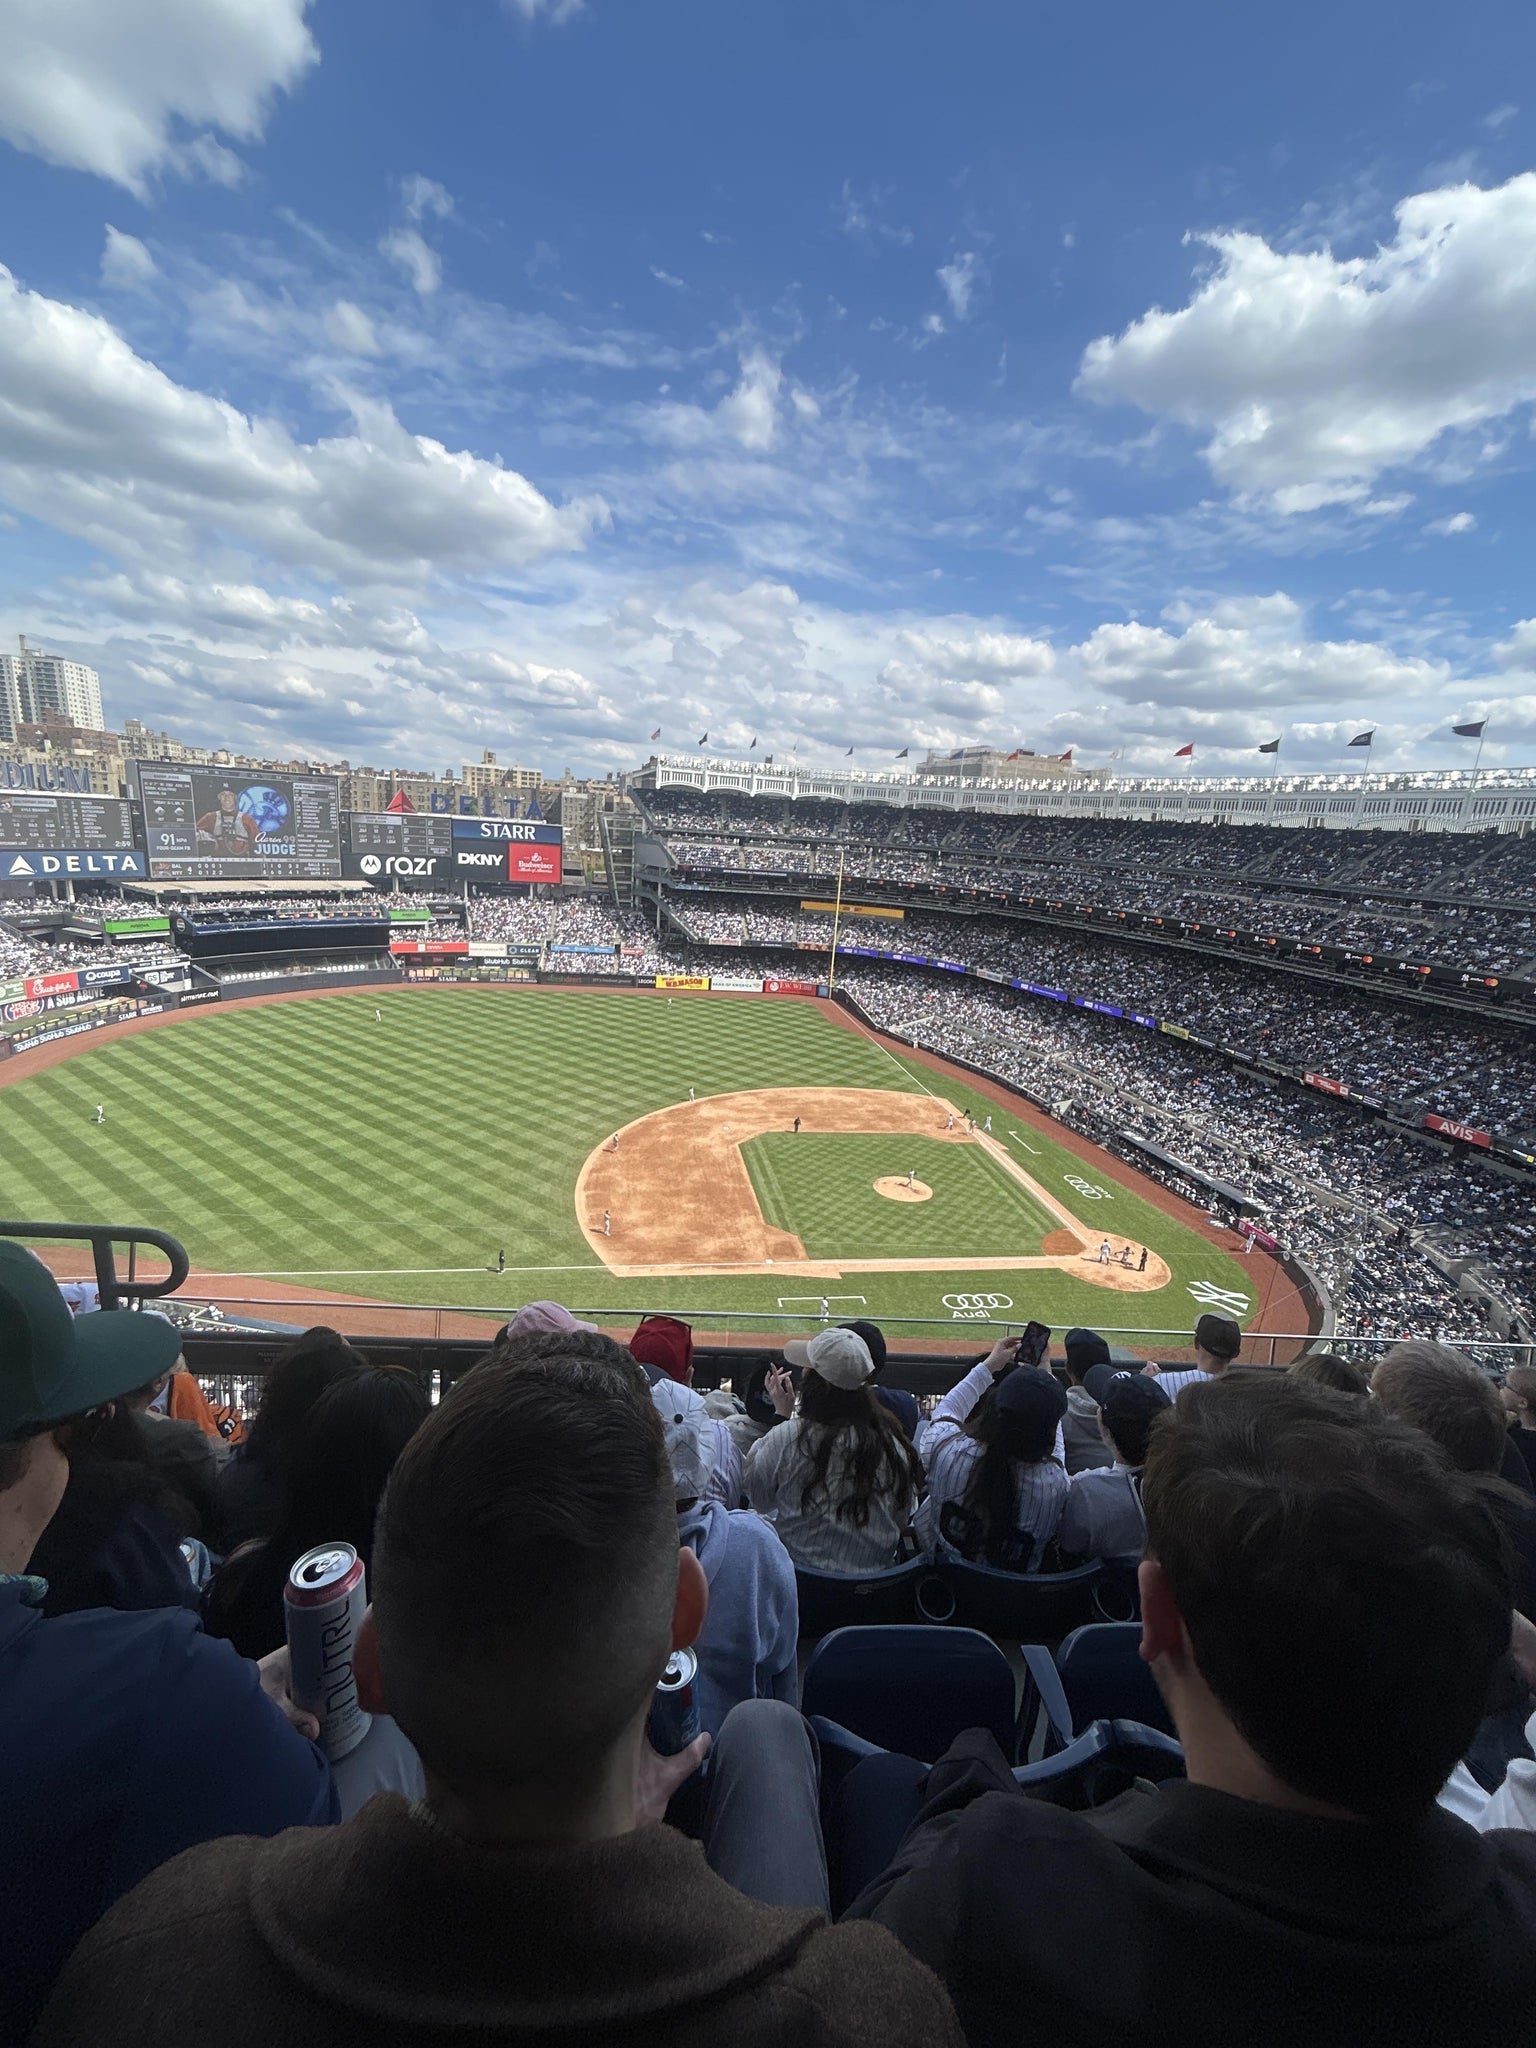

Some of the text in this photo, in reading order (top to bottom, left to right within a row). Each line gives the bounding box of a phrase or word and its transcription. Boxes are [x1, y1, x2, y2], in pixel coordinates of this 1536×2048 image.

[431, 793, 544, 820] DELTA
[480, 822, 536, 840] STARR
[160, 833, 175, 846] 91
[283, 835, 296, 844] 99
[254, 843, 296, 855] JUDGE
[42, 855, 138, 873] DELTA
[457, 852, 504, 866] DKNY
[518, 860, 554, 869] Budweiser
[385, 856, 437, 876] razr
[483, 957, 510, 966] StubHub
[95, 969, 121, 979] coupa
[56, 992, 75, 1007] SUB
[76, 987, 105, 1003] ABOVE
[118, 1010, 138, 1022] STARR
[39, 1031, 65, 1043] StubHub
[66, 1023, 92, 1036] StubHub
[1438, 1121, 1474, 1141] AVIS
[952, 1310, 991, 1319] Audi
